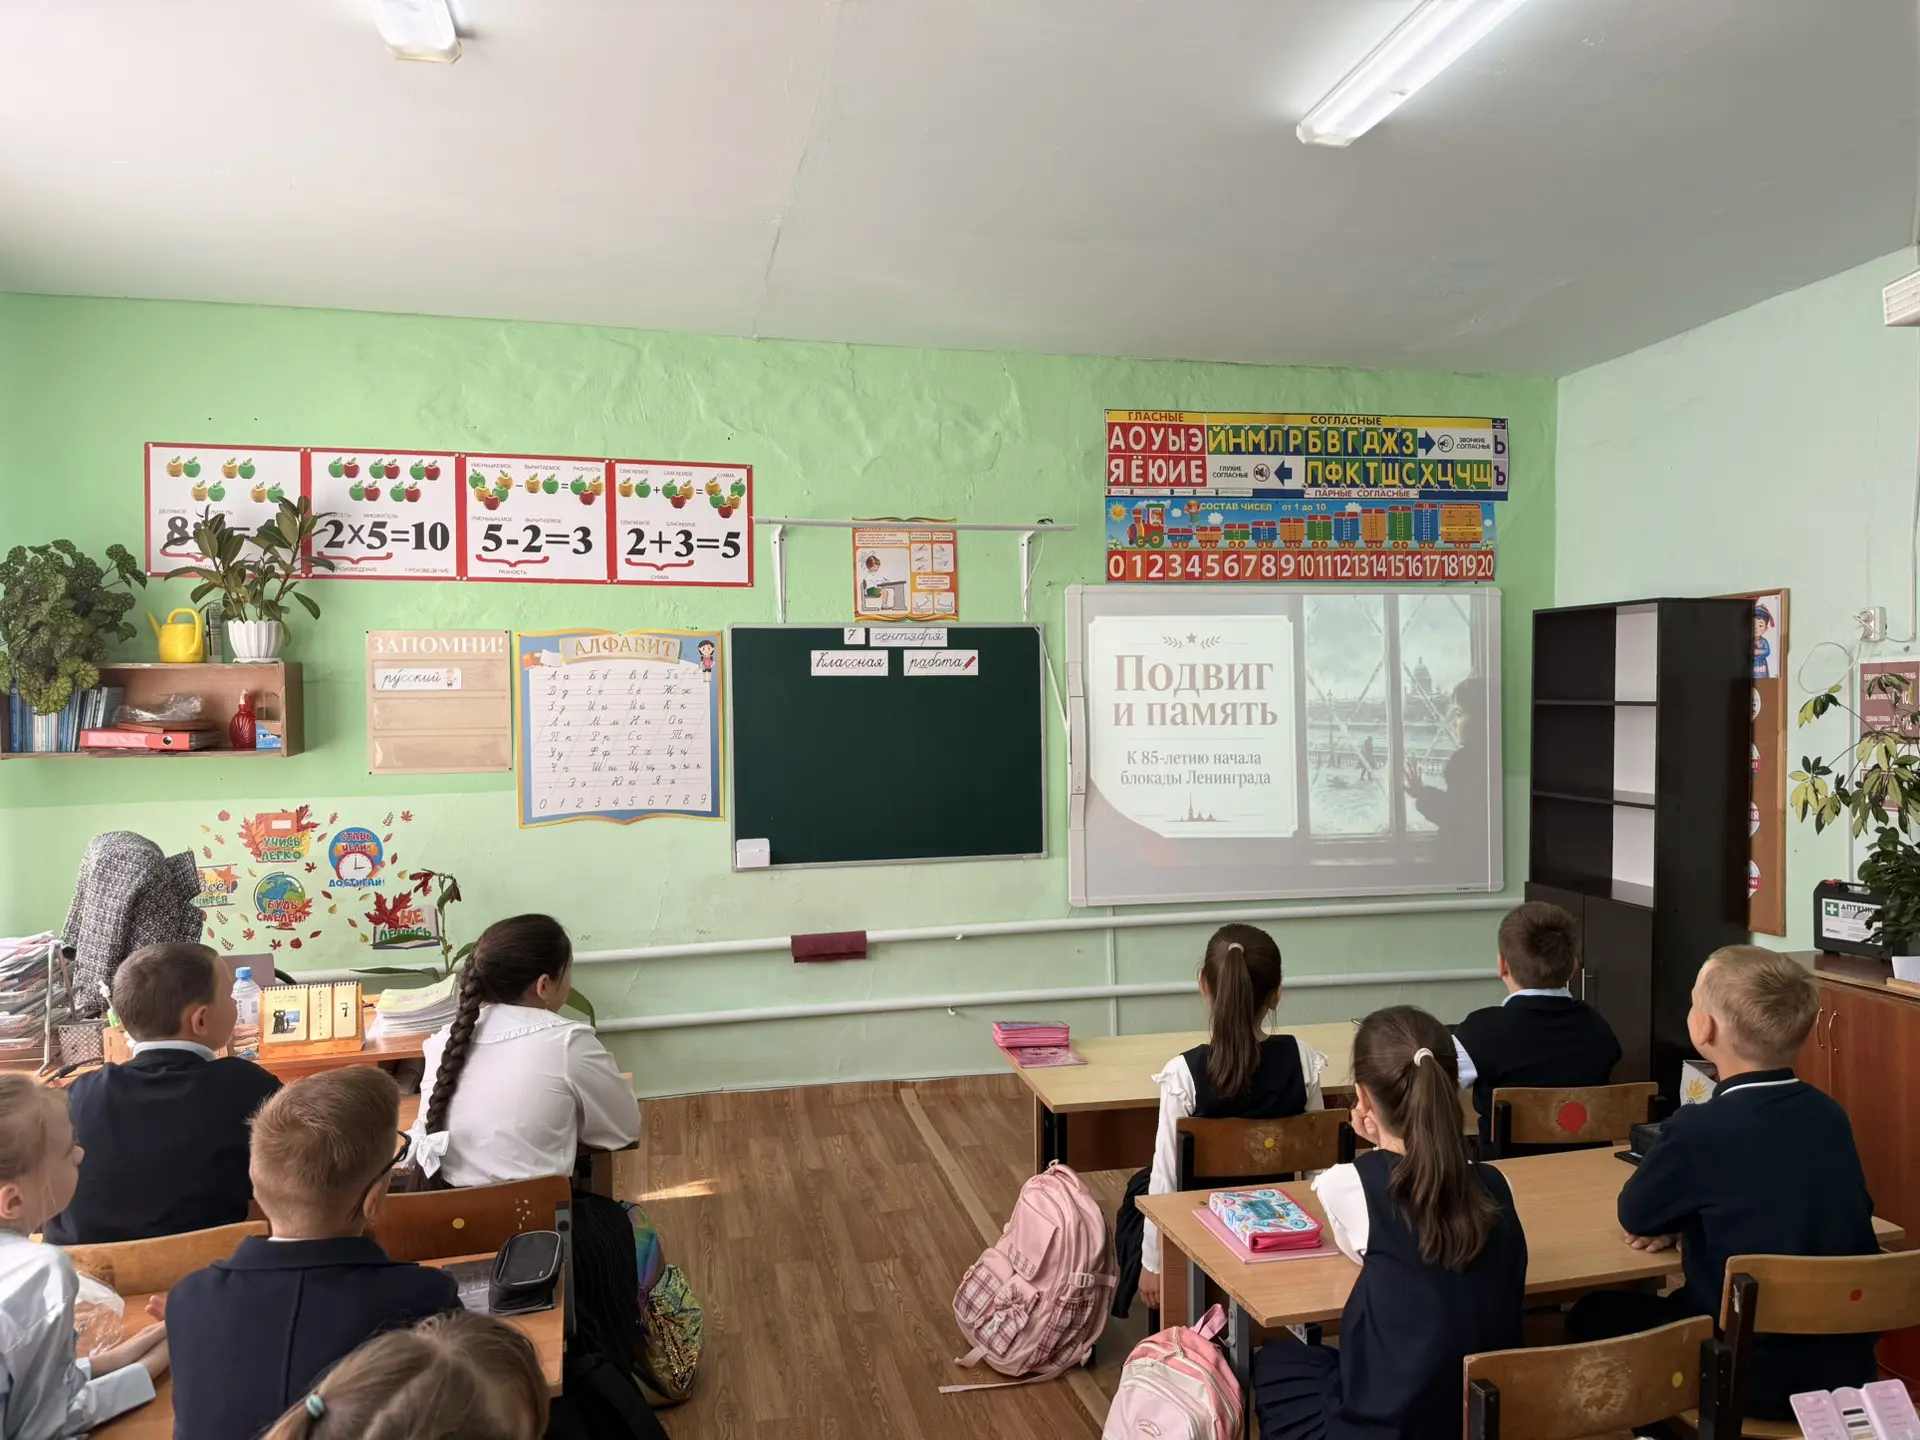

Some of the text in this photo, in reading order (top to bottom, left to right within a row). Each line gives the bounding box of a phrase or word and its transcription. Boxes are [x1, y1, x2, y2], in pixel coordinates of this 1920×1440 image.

[1128, 412, 1184, 422] ГЛАСНЫЕ
[1310, 415, 1381, 425] СОГЛАСНЫЕ
[1315, 490, 1410, 498] ПАРНЫЕ СОГЛАСНЫЕ
[1200, 503, 1238, 511] СОСТАВ
[1241, 503, 1272, 511] ЧИСЕЛ
[1294, 503, 1299, 511] 1
[1315, 503, 1327, 511] 10
[1109, 553, 1493, 577] 0 1 2 3 4 5 6 7 8 9 10 11 12 13 14 15 16 17 18 19 20
[848, 628, 857, 641] 7
[371, 637, 503, 653] ЗАПОМНИ!
[575, 637, 675, 656] АЛФАВИТ
[816, 652, 964, 673] Классная работа
[1114, 655, 1274, 698] Подвиг
[1113, 702, 1278, 726] и память
[1127, 751, 1262, 765] К 85-летию начала
[1121, 769, 1271, 788] блокады Ленинграда
[264, 837, 301, 847] УЧИСЬ
[261, 850, 302, 861] ЛЕГКО
[268, 900, 298, 910] БУДЬ
[399, 909, 424, 924] НЕ
